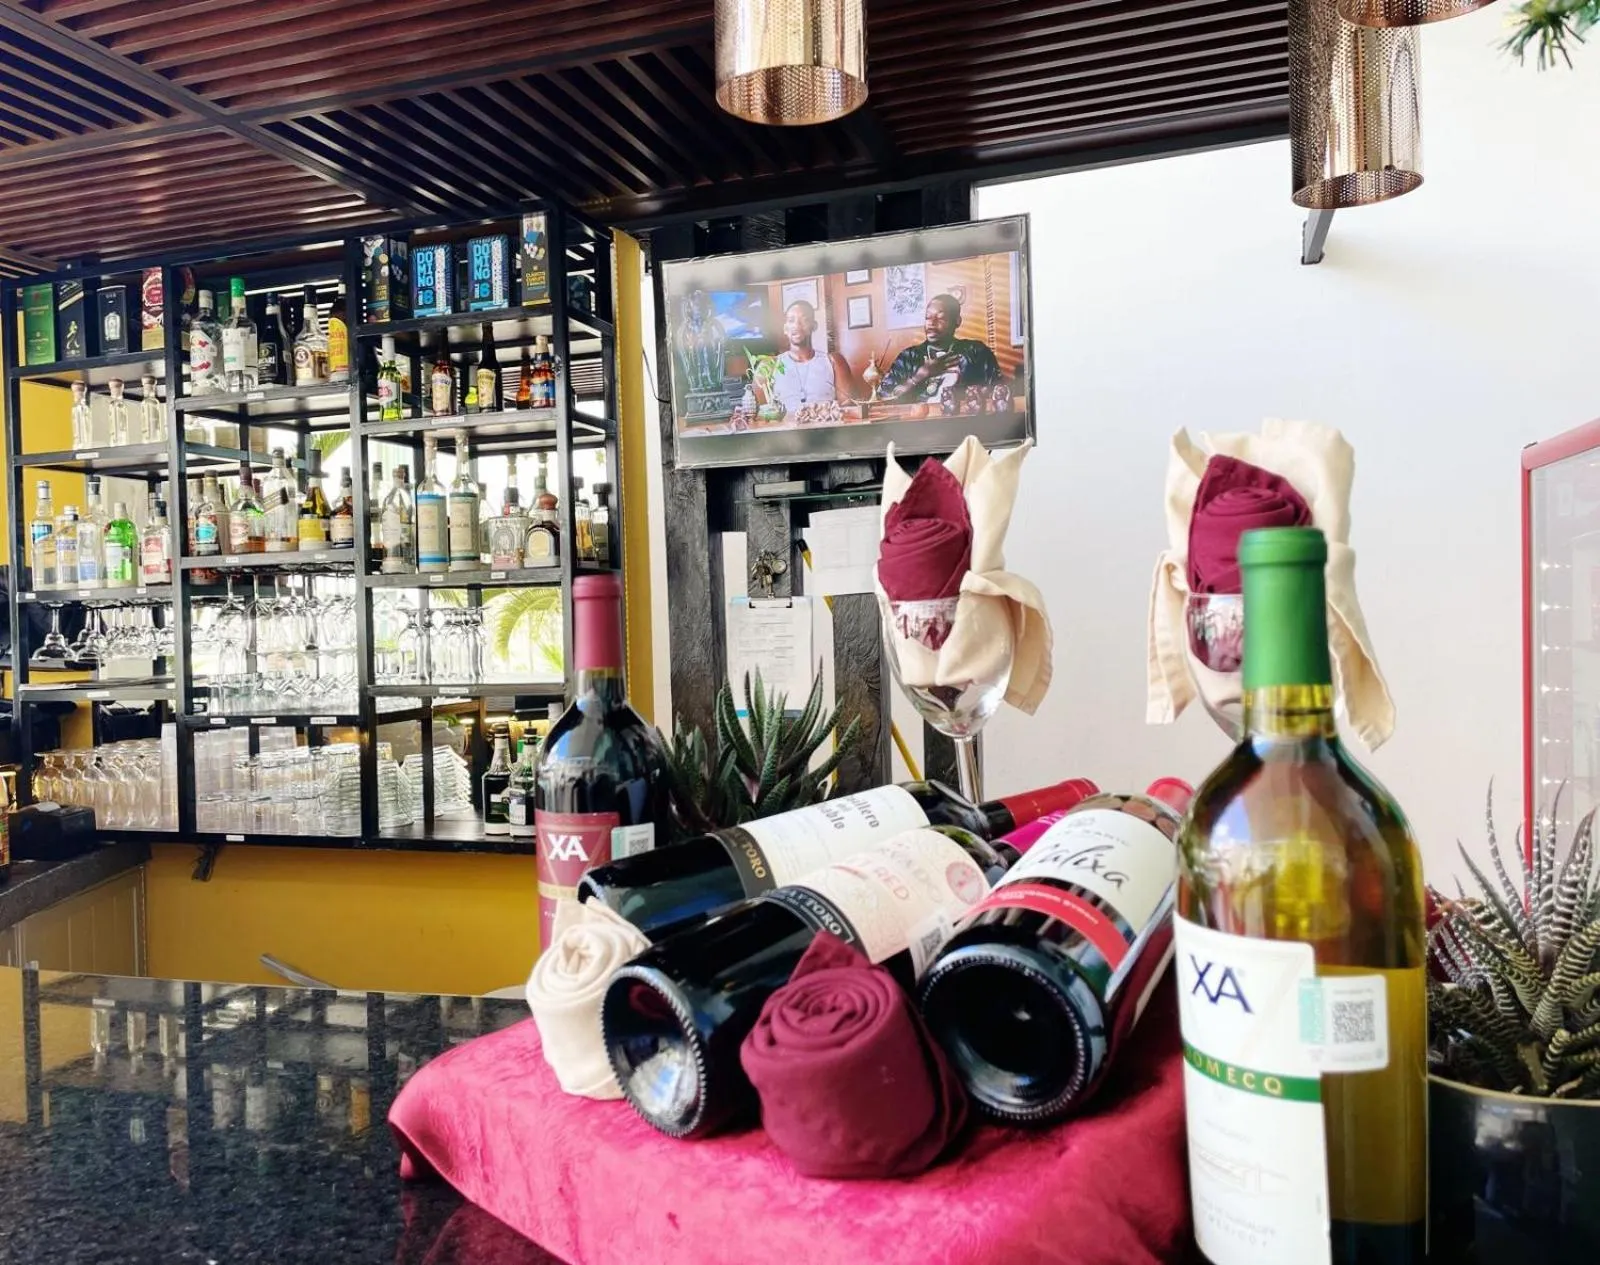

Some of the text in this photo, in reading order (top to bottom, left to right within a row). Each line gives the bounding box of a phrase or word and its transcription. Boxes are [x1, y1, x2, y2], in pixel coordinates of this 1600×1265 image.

[416, 251, 433, 264] DO
[473, 243, 489, 256] DO
[417, 274, 434, 287] NO
[474, 268, 491, 280] NO
[546, 833, 590, 862] XA
[743, 842, 767, 879] TORO
[805, 899, 842, 936] TORO
[1189, 953, 1255, 1016] XA
